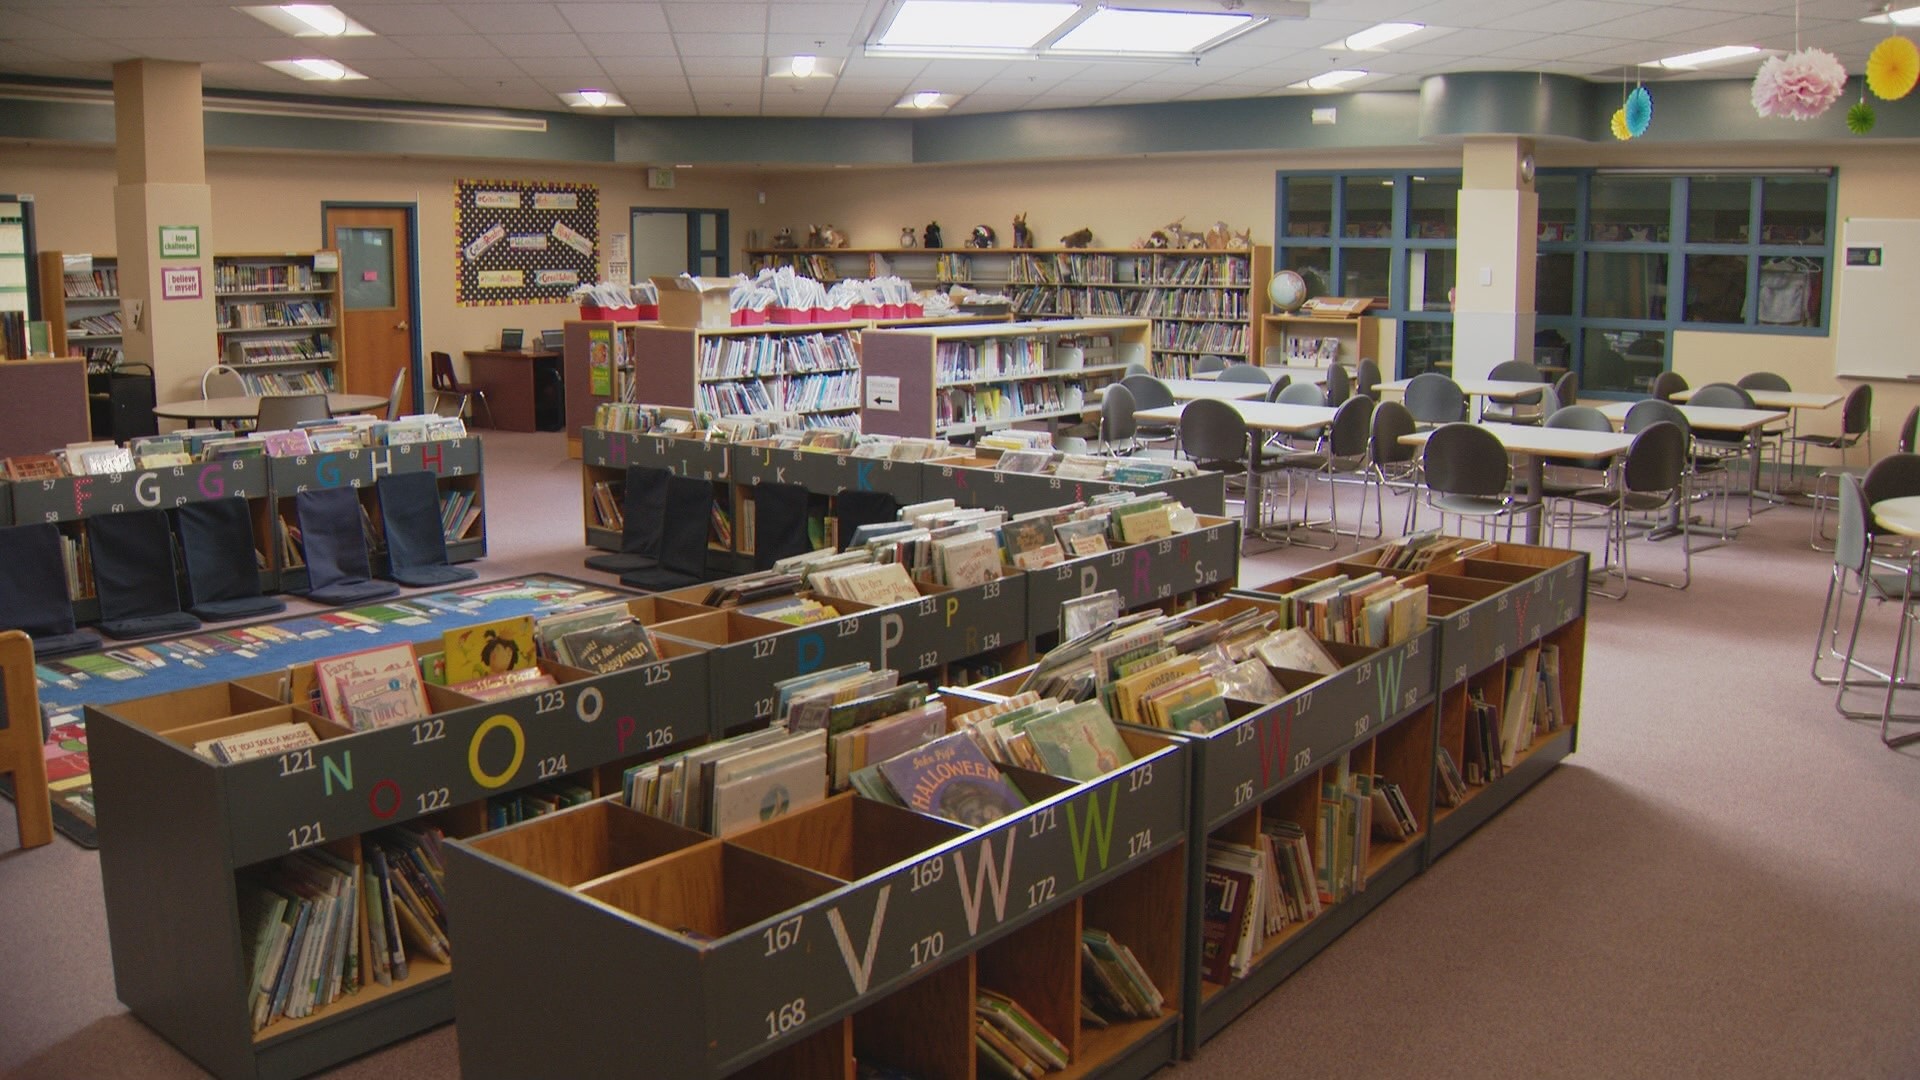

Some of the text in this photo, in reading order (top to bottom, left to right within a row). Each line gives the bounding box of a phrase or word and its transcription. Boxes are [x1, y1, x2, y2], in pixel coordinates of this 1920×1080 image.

[165, 243, 195, 251] challenges
[175, 234, 188, 242] love
[172, 274, 195, 284] believe
[175, 284, 197, 293] myself
[349, 450, 359, 459] 67
[400, 444, 410, 454] 69
[452, 439, 461, 448] 71
[610, 434, 627, 464] H
[655, 438, 665, 454] H
[751, 447, 760, 456] 81
[232, 459, 244, 470] 63
[296, 456, 307, 466] 65
[371, 449, 392, 482] H
[422, 443, 443, 473] H
[718, 447, 729, 478] J
[763, 449, 770, 466] J
[793, 452, 802, 461] 83
[837, 456, 846, 466] 85
[883, 460, 893, 471] 87
[110, 473, 122, 484] 59
[173, 466, 185, 477] 61
[197, 464, 225, 499] G
[316, 456, 341, 488] G
[350, 478, 361, 488] 68
[453, 466, 462, 476] 72
[776, 466, 786, 484] K
[857, 462, 875, 491] K
[942, 467, 953, 477] 89
[955, 470, 968, 488] K
[994, 472, 1004, 483] 91
[43, 480, 56, 491] 57
[135, 472, 161, 508] G
[1049, 479, 1061, 489] 93
[73, 478, 93, 517] F
[111, 503, 124, 513] 60
[45, 511, 59, 522] 58
[1206, 528, 1219, 543] 141
[1111, 552, 1125, 567] 137
[1158, 541, 1172, 556] 139
[1179, 538, 1190, 561] R
[1057, 565, 1073, 581] 135
[1131, 549, 1151, 598] R
[1195, 561, 1204, 585] S
[1205, 570, 1218, 585] 142
[982, 583, 1001, 599] 133
[1158, 583, 1171, 599] 140
[1549, 575, 1558, 602] Y
[919, 598, 938, 616] 131
[946, 597, 959, 628] P
[837, 617, 859, 638] 129
[1456, 613, 1471, 631] 183
[1514, 591, 1531, 648] Y
[752, 637, 777, 659] 127
[879, 613, 904, 670] P
[983, 632, 1001, 650] 134
[1406, 637, 1420, 660] 181
[918, 651, 938, 670] 132
[644, 663, 672, 686] 125
[1356, 662, 1372, 686] 179
[1376, 647, 1405, 723] W
[535, 690, 565, 714] 123
[576, 686, 604, 723] O
[1295, 692, 1313, 717] 177
[1404, 687, 1418, 709] 182
[412, 719, 447, 746] 122
[617, 716, 636, 752] P
[1235, 719, 1255, 747] 175
[1354, 715, 1370, 738] 180
[228, 729, 310, 754] IF YOU TAKE A MOUSE
[646, 727, 673, 751] 126
[1257, 702, 1294, 792] W
[256, 748, 267, 757] TO
[279, 749, 316, 778] 121
[468, 714, 526, 789] O
[1293, 747, 1312, 775] 178
[322, 750, 354, 796] N
[537, 754, 568, 780] 124
[1129, 763, 1153, 793] 173
[911, 760, 1001, 812] HALLOWEEN
[1234, 779, 1254, 808] 176
[368, 779, 402, 820] O
[417, 787, 451, 815] 122
[1028, 807, 1057, 839] 171
[1066, 780, 1120, 882] W
[288, 821, 326, 851] 121
[1127, 828, 1152, 860] 174
[910, 858, 945, 892] 169
[953, 825, 1017, 937] W
[1027, 876, 1057, 909] 172
[762, 915, 804, 958] 167
[827, 884, 892, 996] V
[910, 931, 945, 970] 170
[765, 997, 807, 1042] 168
